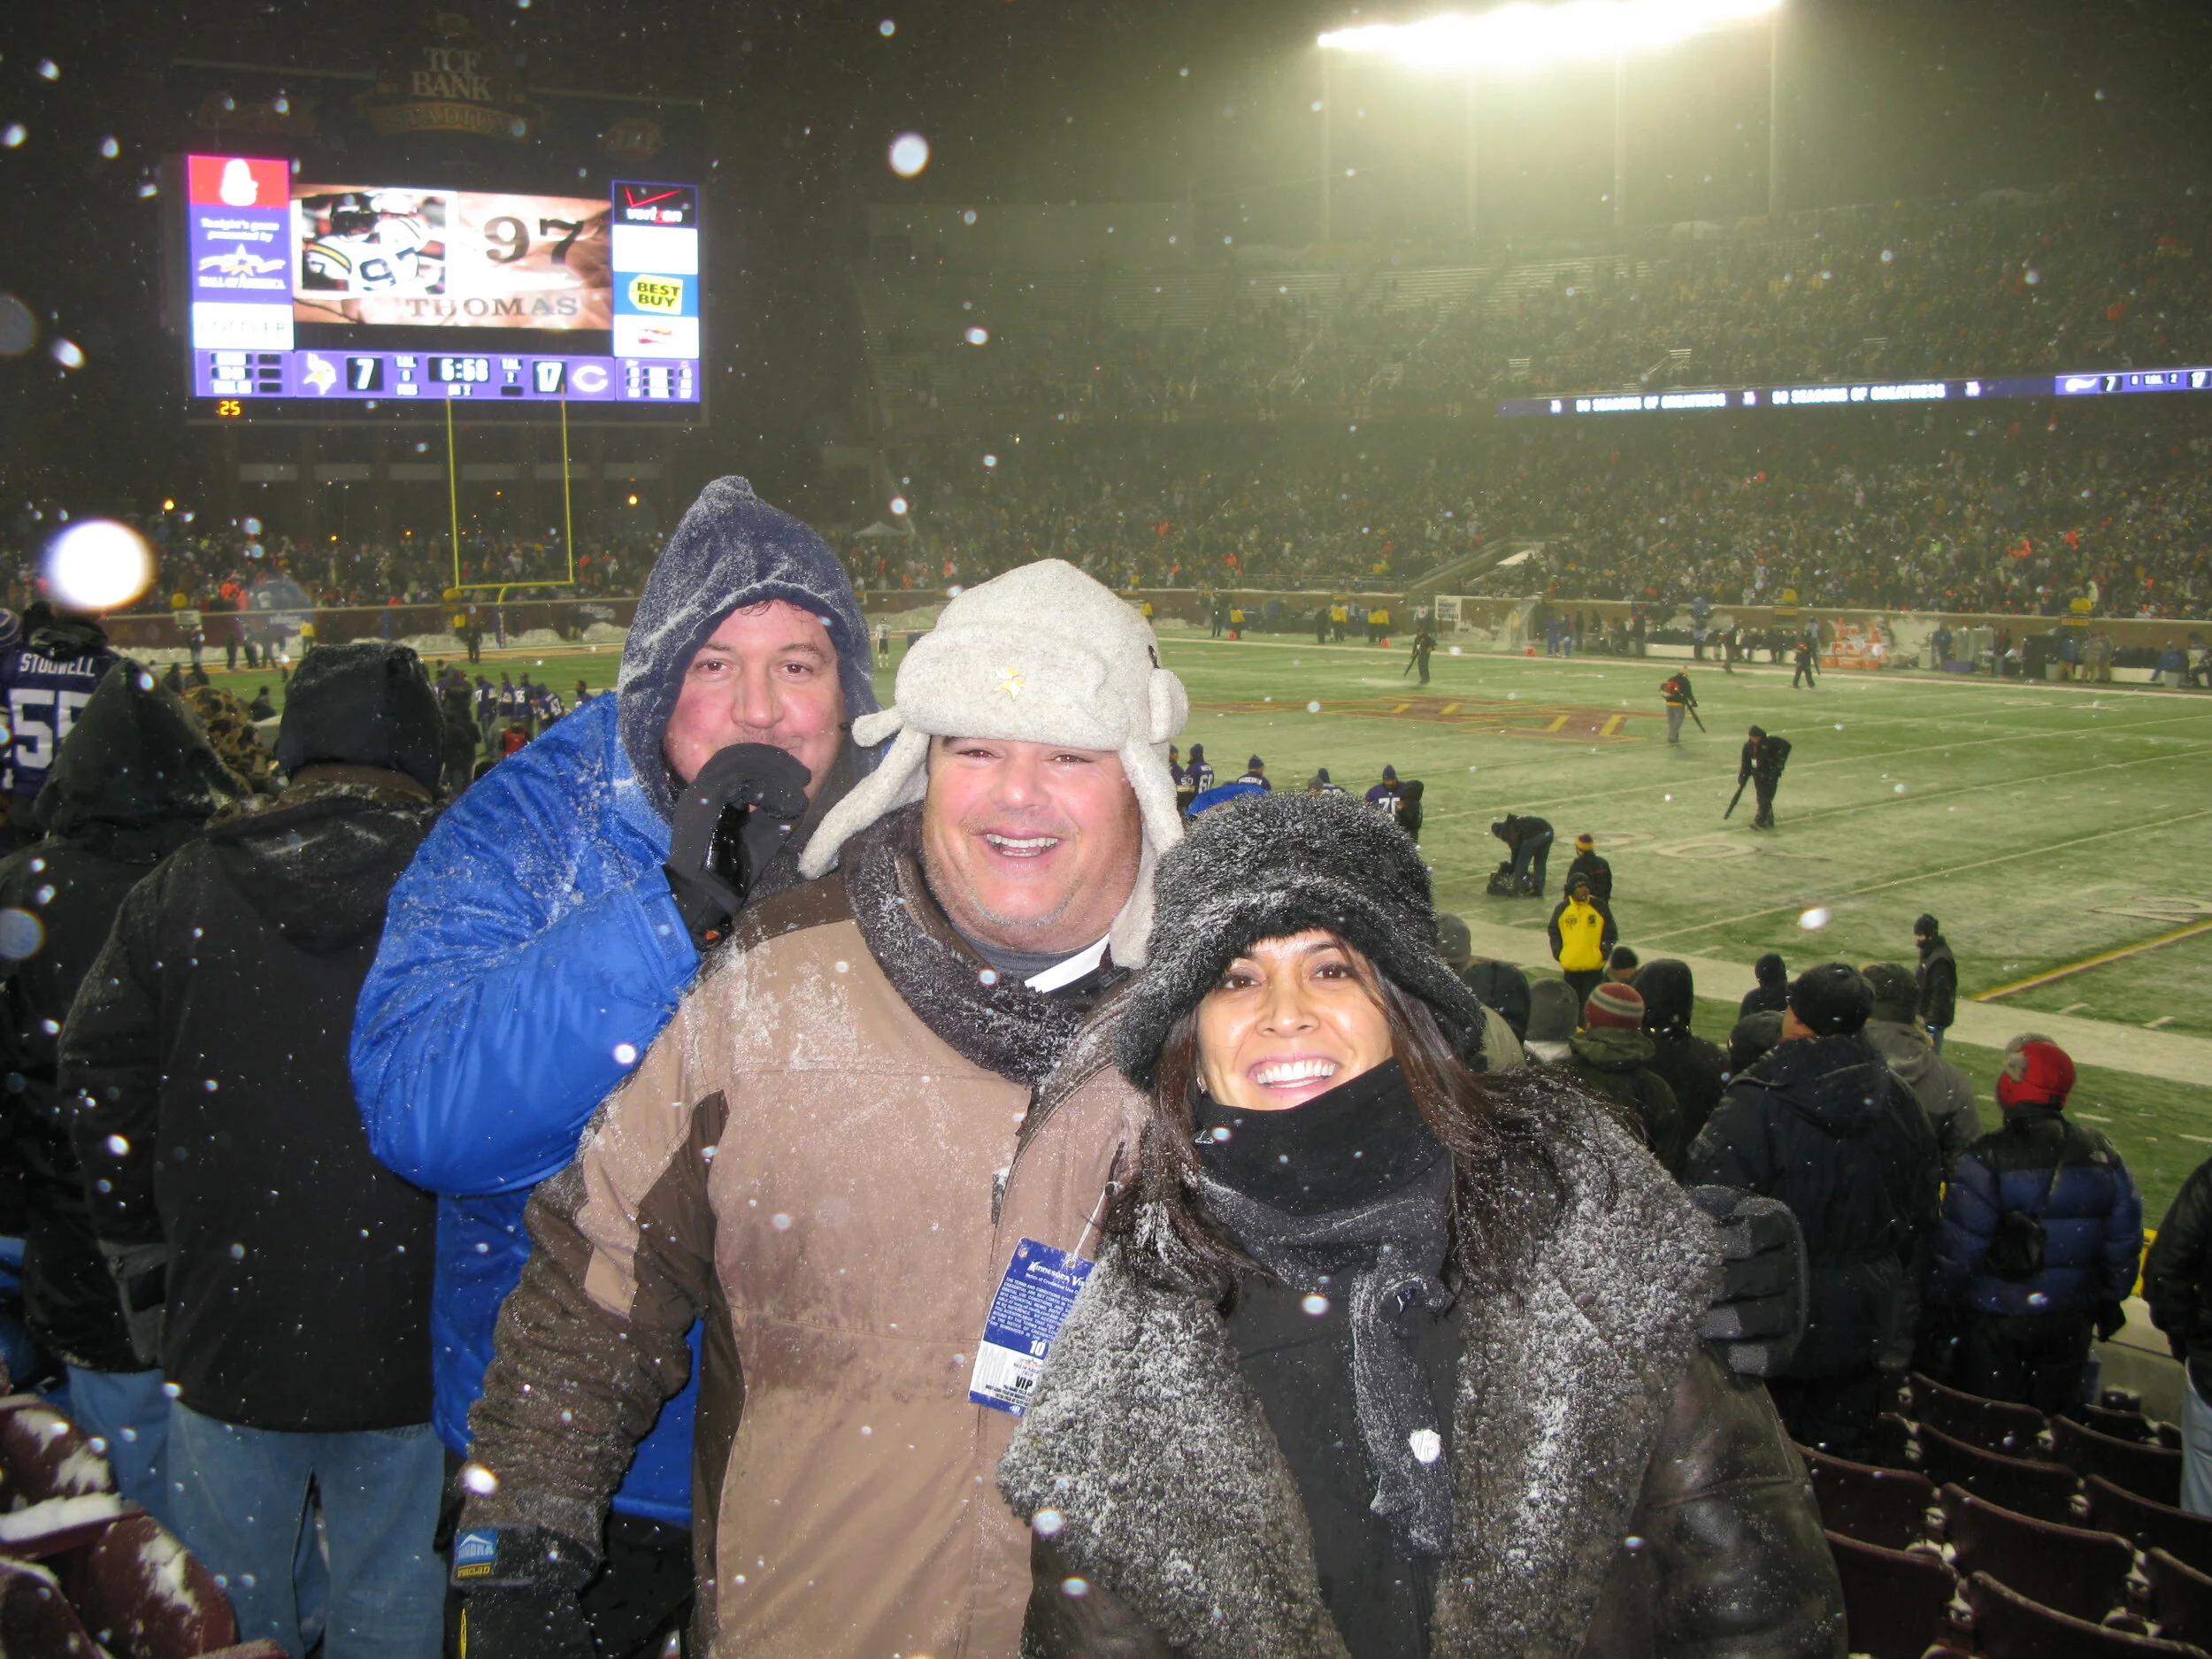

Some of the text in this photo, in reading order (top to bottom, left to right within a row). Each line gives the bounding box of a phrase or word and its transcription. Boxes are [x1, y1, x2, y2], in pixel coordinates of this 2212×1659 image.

[422, 47, 481, 75] TCF
[411, 71, 494, 101] BANK
[626, 206, 682, 224] verizon
[484, 216, 584, 265] 97
[637, 282, 680, 297] BEST
[405, 297, 578, 319] THOMAS
[639, 294, 675, 307] BUY
[357, 358, 374, 389] 7
[537, 362, 563, 392] 17
[2106, 375, 2116, 392] 7
[220, 401, 241, 416] 25
[1162, 410, 1179, 423] 15
[1257, 408, 1276, 421] 54
[1030, 1340, 1046, 1356] 10
[1016, 1376, 1033, 1390] VIP
